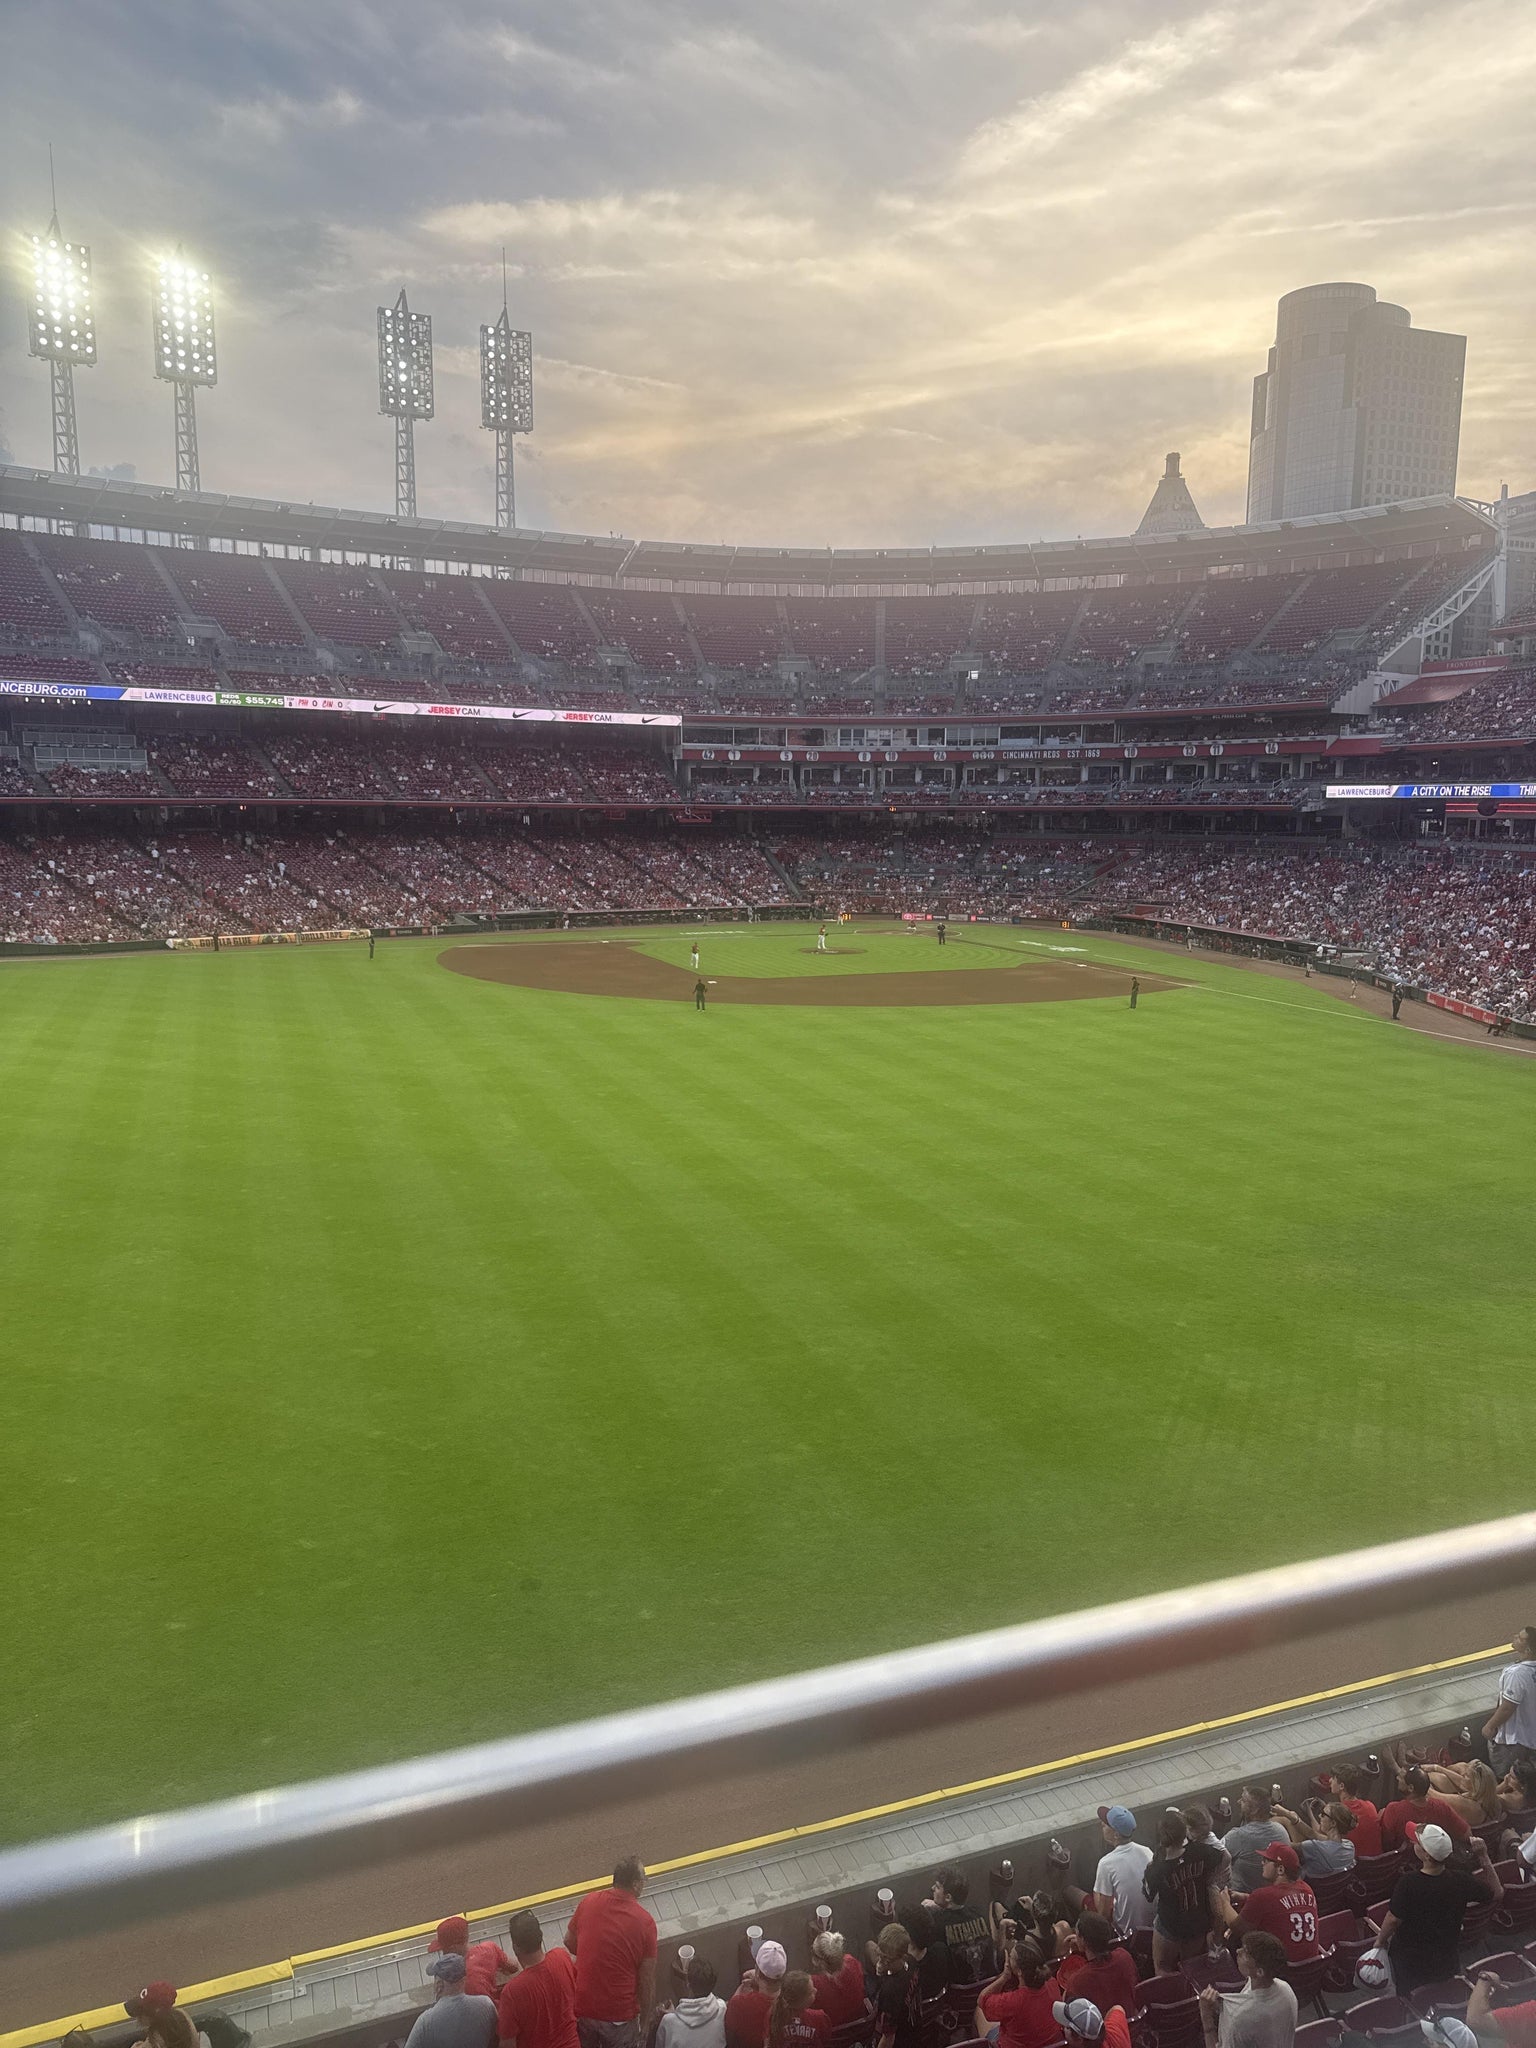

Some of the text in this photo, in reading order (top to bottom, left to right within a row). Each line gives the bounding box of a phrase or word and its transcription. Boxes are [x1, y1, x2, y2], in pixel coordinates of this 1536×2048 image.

[144, 692, 213, 702] LAWRENCEBURG
[245, 696, 284, 705] $55,745
[1002, 751, 1041, 759] CINCINNATI
[1043, 751, 1060, 759] REDS
[1085, 749, 1100, 758] 1869
[1338, 788, 1391, 796] LAWRENCEBURG
[1412, 785, 1491, 795] A CITY ON THE RISE!
[1520, 785, 1536, 795] THI
[1290, 1912, 1315, 1942] 33
